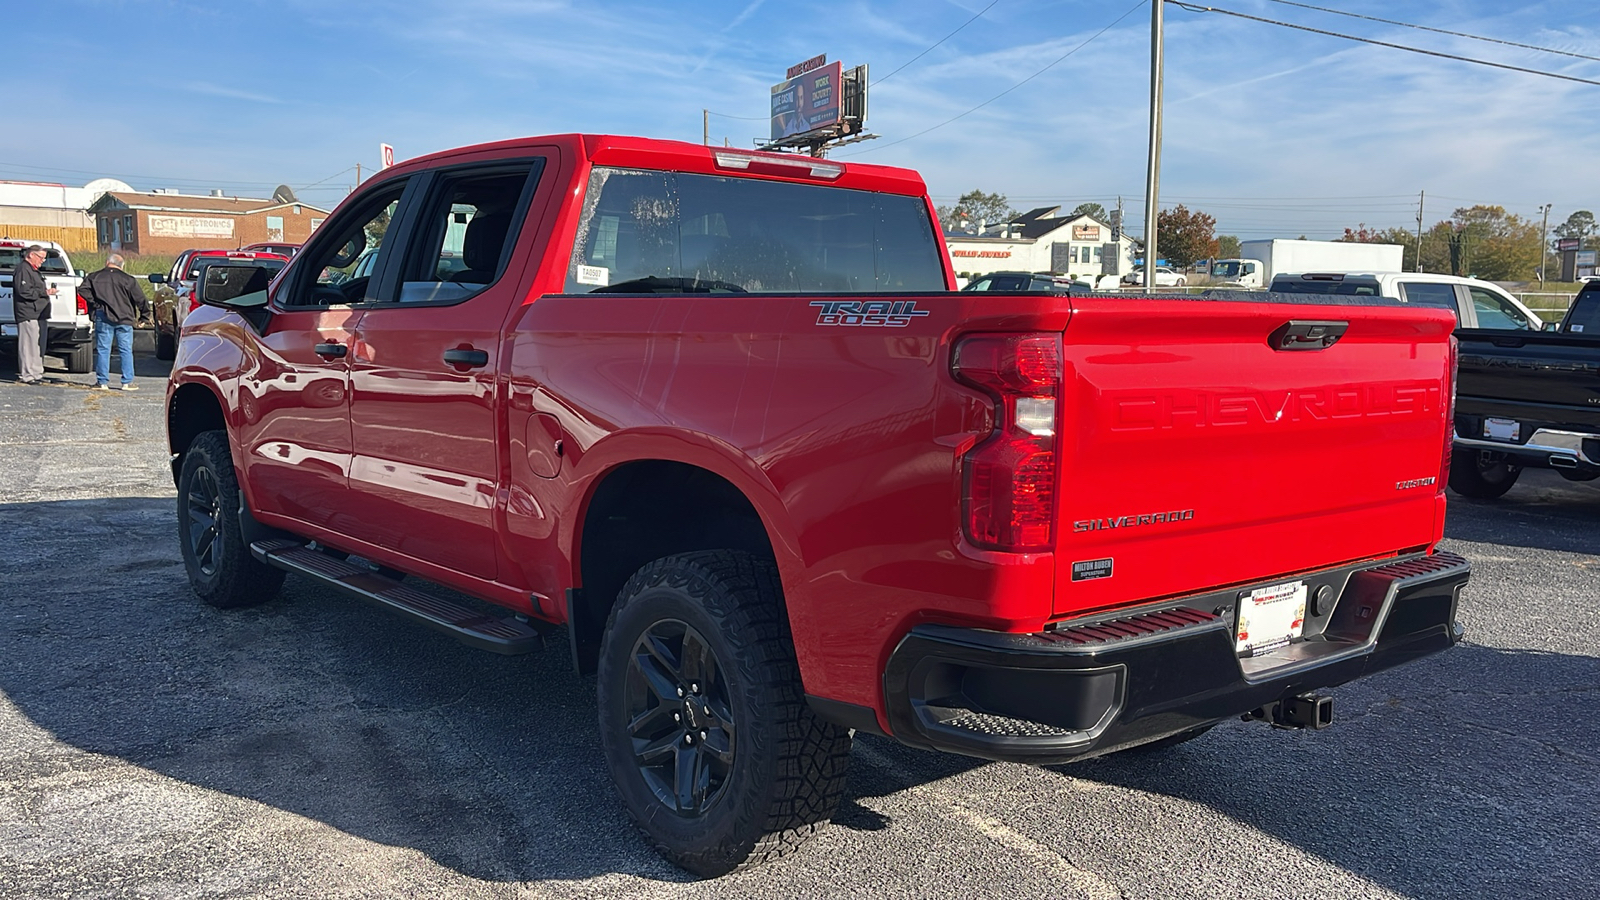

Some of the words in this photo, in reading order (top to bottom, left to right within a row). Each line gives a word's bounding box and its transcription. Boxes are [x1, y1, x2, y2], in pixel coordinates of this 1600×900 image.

[180, 219, 232, 229] ELECTRONICS
[1111, 226, 1120, 238] 45
[809, 301, 930, 316] TRAIL
[815, 313, 912, 327] BOSS
[1110, 383, 1439, 432] CHEVROLET
[1395, 476, 1436, 490] CUSTOM
[1073, 508, 1195, 533] SILVERADO
[1074, 562, 1094, 572] MILTON
[1094, 560, 1111, 569] RUBEN
[1275, 591, 1294, 599] RUBEN
